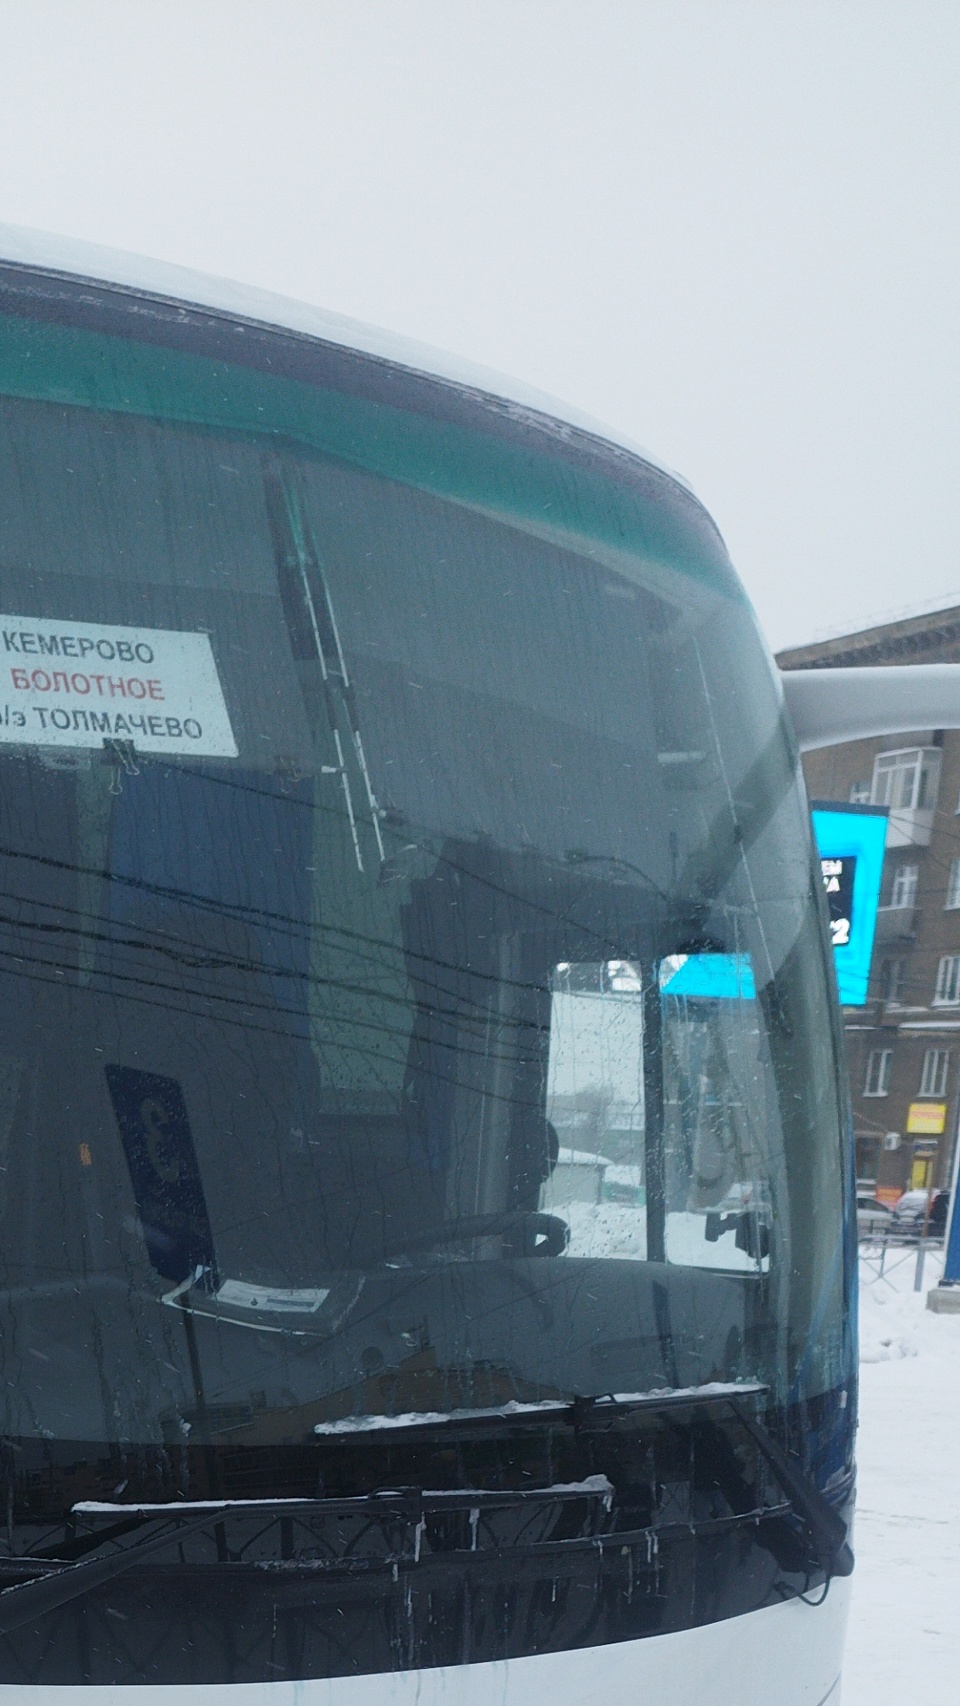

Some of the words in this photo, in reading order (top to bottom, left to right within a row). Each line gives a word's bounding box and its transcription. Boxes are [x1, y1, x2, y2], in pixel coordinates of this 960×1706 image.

[2, 630, 154, 665] КЕМЕРОВО
[10, 667, 166, 701] БОЛОТНОЕ
[32, 706, 203, 739] ТОЛМАЧЕВО
